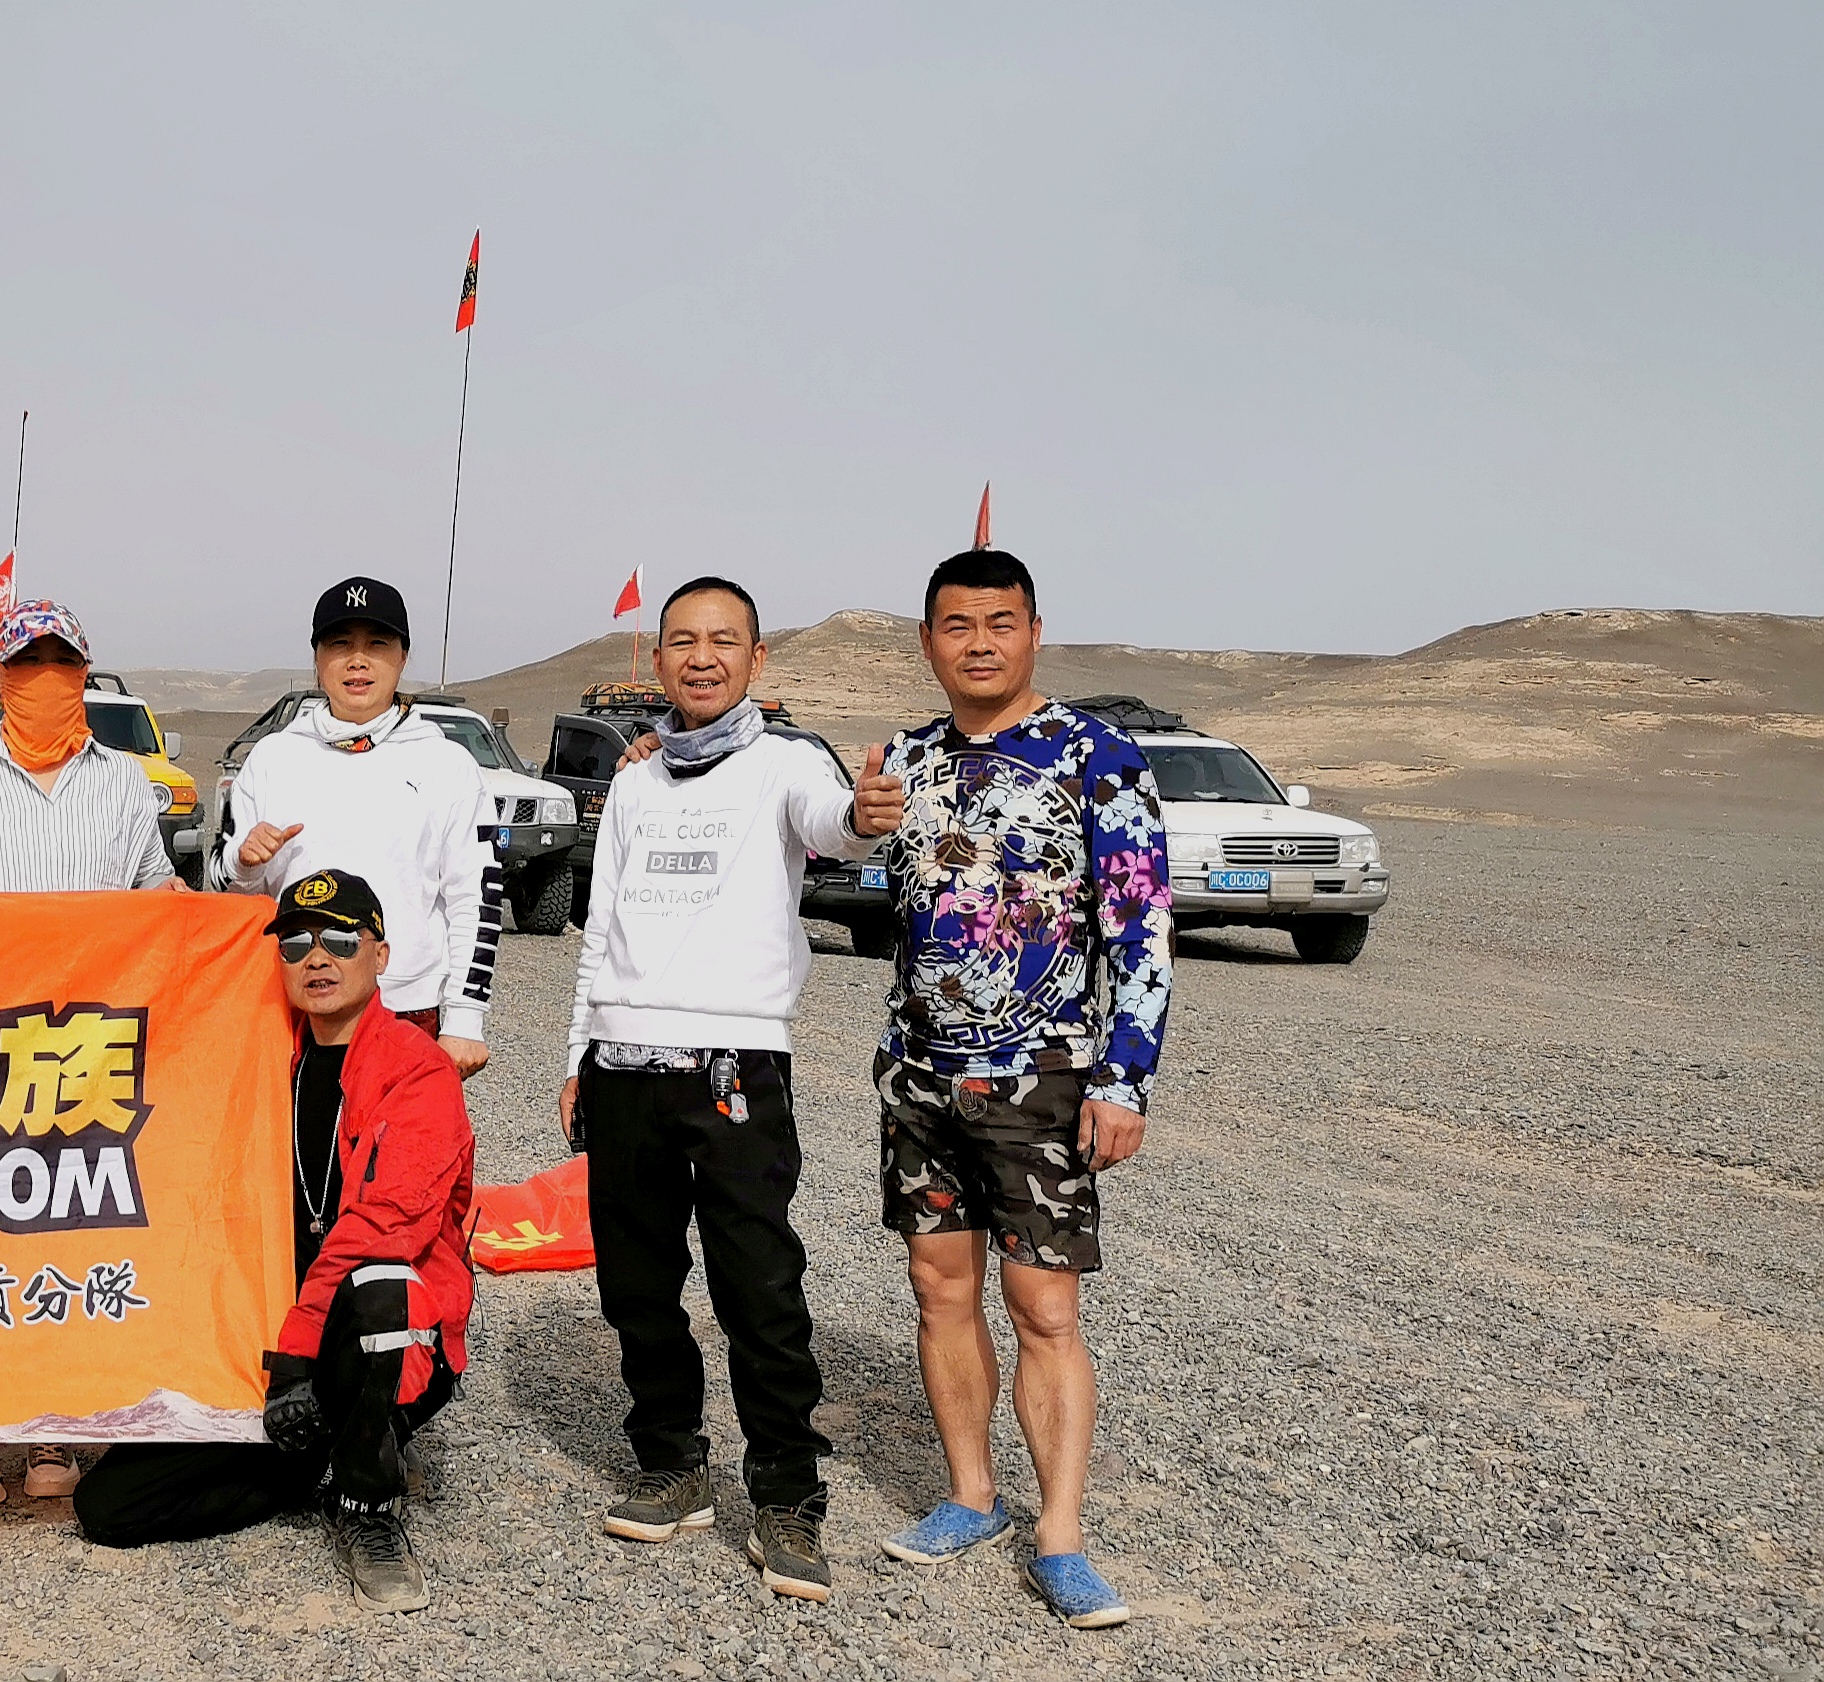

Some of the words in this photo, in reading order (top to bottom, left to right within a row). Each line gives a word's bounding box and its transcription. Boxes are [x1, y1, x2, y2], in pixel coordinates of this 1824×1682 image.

[346, 585, 367, 607] NY
[650, 854, 714, 871] DELLA
[623, 885, 721, 905] MONTAGNA
